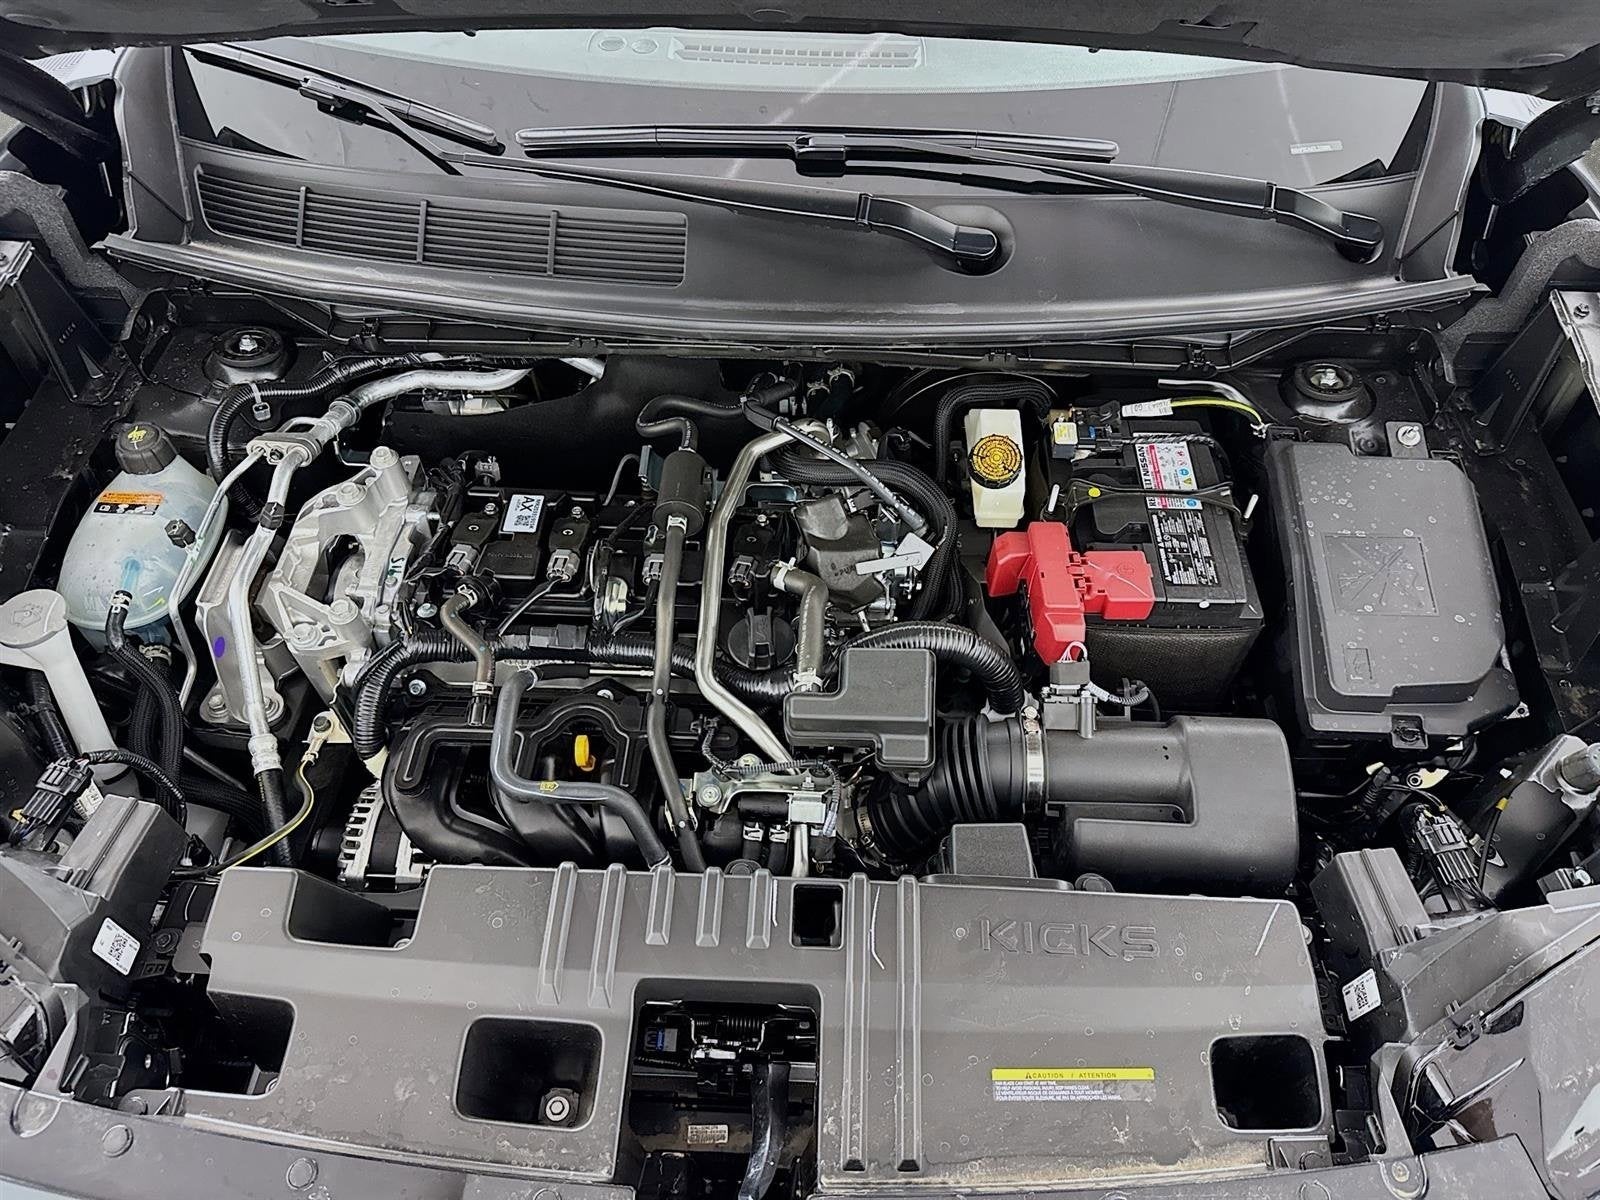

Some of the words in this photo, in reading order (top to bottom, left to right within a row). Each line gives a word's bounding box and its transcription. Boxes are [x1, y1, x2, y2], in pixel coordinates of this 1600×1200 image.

[1138, 446, 1150, 477] NISSAN
[519, 496, 535, 512] AX
[980, 919, 1161, 959] KICKS
